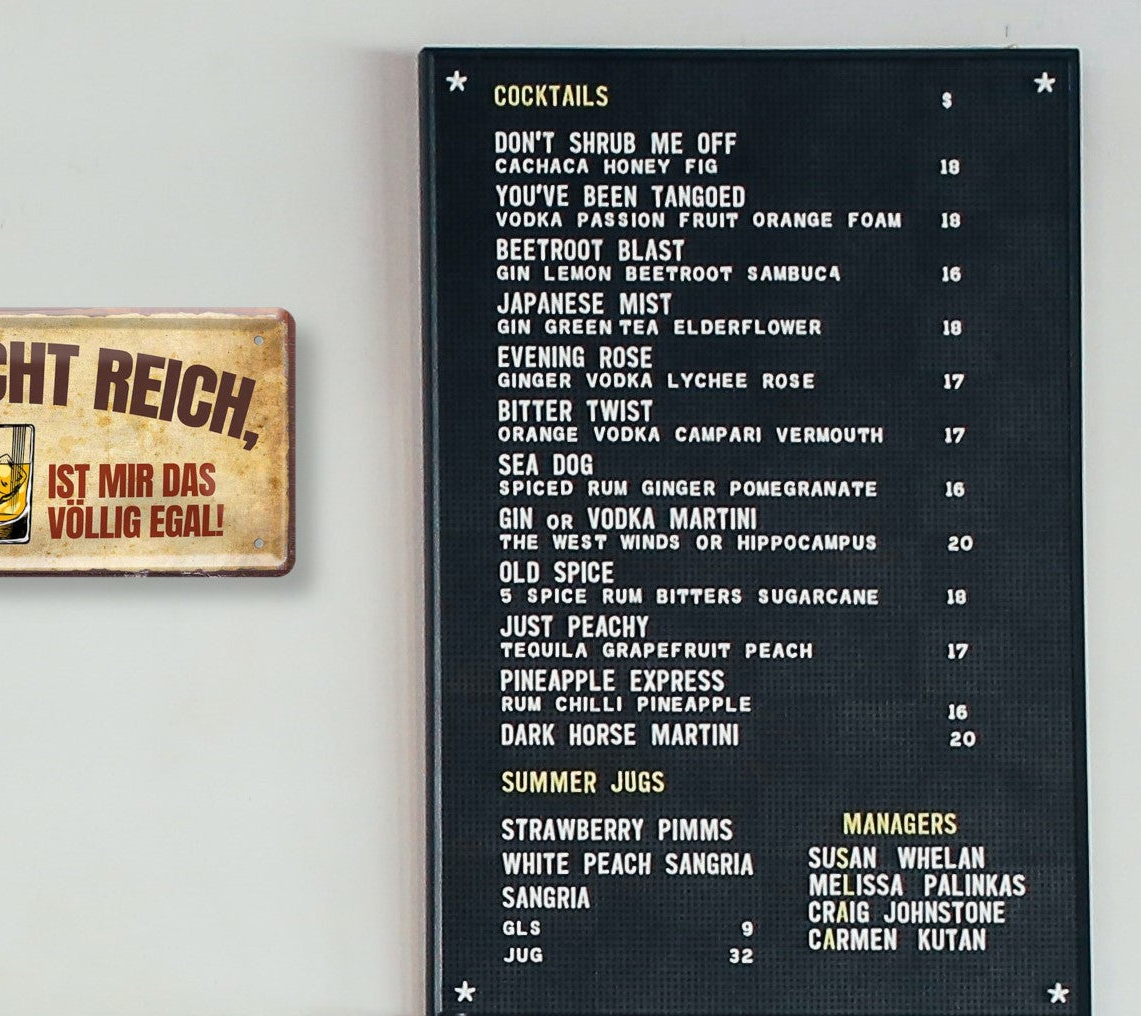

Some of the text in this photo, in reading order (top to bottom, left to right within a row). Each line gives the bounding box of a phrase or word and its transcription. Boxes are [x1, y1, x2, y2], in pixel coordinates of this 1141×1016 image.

[495, 85, 608, 106] COCKTAILS
[942, 92, 952, 109] $
[495, 131, 736, 154] DON'T SHRUB ME OFF
[496, 158, 717, 174] CACHACA HONEY FIG
[941, 159, 959, 175] 18
[496, 184, 745, 208] YOU'VE BEEN TANGOED
[496, 212, 901, 228] VODKA PASSION FRUIT ORANGE FOAM
[942, 213, 960, 228] 18
[497, 239, 684, 261] BEETROOT BLAST
[497, 266, 840, 281] GIN LEMON BEETROOT SAMBUCA
[942, 267, 961, 282] 16
[497, 292, 671, 315] JAPANESE MIST
[498, 319, 821, 335] GIN GREEN TEA ELDERFLOWER
[943, 320, 961, 335] 18
[498, 346, 652, 369] EVENING ROSE
[498, 373, 814, 389] GINGER VODKA LYCHEE ROSE
[944, 374, 964, 389] 17
[94, 347, 259, 450] REICH,
[499, 400, 652, 422] BITTER TWIST
[498, 426, 883, 443] ORANGE VODKA CAMPARI VERMOUTH
[945, 428, 965, 443] 17
[499, 454, 593, 475] SEA DOG
[48, 462, 216, 499] IST MIR DAS
[500, 480, 877, 497] SPICED RUM GINGER POMEGRANATE
[946, 481, 964, 497] 16
[48, 499, 225, 539] VÖLLIG EGAL!
[500, 507, 756, 530] GIN OR VODKA MARTINI
[500, 534, 876, 551] THE WEST WINDS OR HIPPOCAMPUS
[948, 536, 973, 551] 20
[500, 561, 613, 583] OLD SPICE
[500, 588, 878, 605] 5 SPICE RUM BITTERS SUGARCANE
[948, 589, 966, 604] 18
[500, 615, 648, 638] JUST PEACHY
[501, 642, 812, 658] TEQUILA GRAPEFRUIT PEACH
[948, 644, 968, 659] 17
[501, 669, 724, 692] PINEAPPLE EXPRESS
[502, 696, 751, 712] RUM CHILLI PINEAPPLE
[948, 704, 967, 720] 16
[502, 723, 738, 746] DARK HORSE MARTINI
[950, 731, 976, 747] 20
[502, 771, 664, 793] SUMMER JUGS
[502, 818, 733, 841] STRAWBERRY PIMMS
[844, 813, 957, 835] MANAGERS
[503, 852, 753, 875] WHITE PEACH SANGRIA
[809, 846, 984, 869] SUSAN WHELAN
[810, 874, 1026, 897] MELISSA PALINKAS
[503, 886, 590, 909] SANGRIA
[809, 901, 1005, 923] CRAIG JOHNSTONE
[503, 921, 540, 935] GLS
[742, 921, 753, 936] 9
[809, 928, 985, 951] CARMEN KUTAN
[504, 947, 542, 962] JUG
[730, 948, 753, 963] 32
